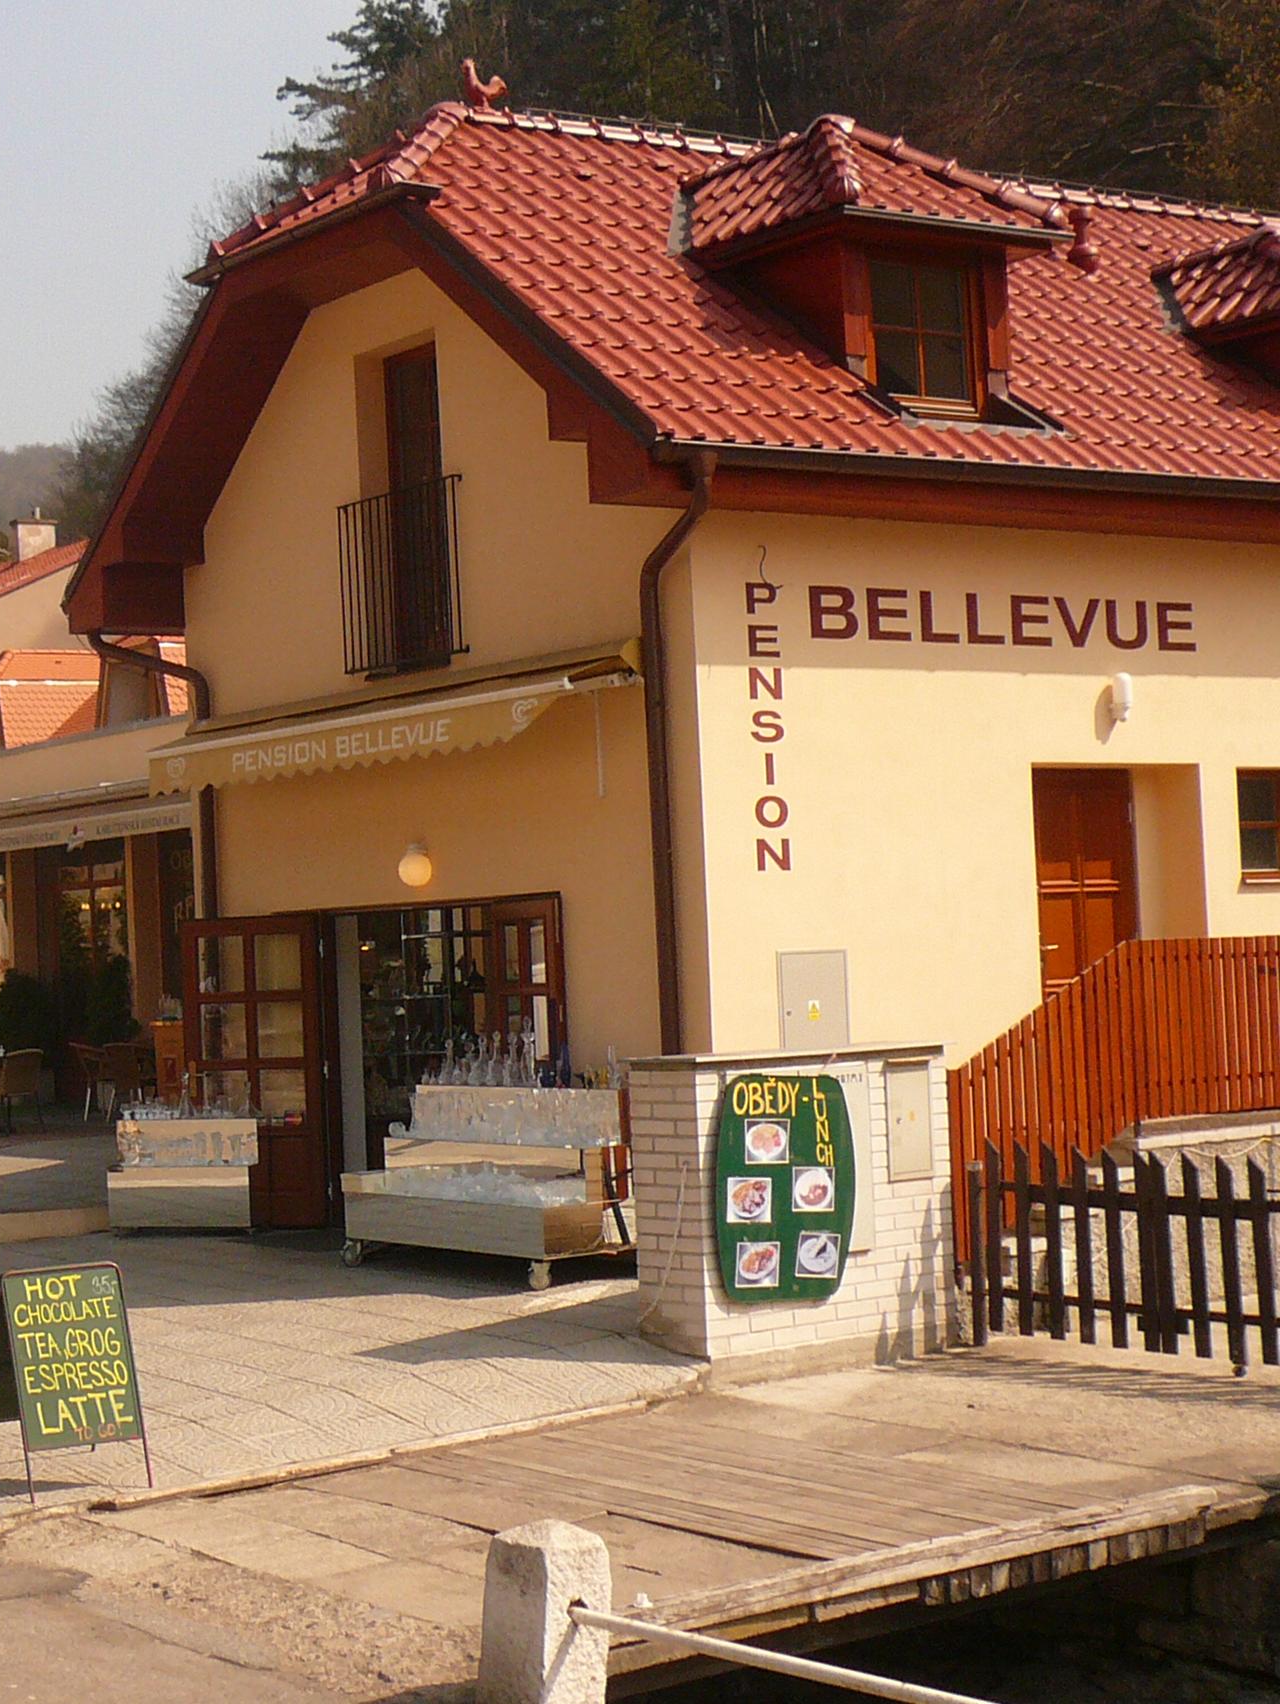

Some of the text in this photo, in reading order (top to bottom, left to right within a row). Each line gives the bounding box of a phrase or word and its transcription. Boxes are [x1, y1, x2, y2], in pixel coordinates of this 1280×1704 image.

[808, 585, 1197, 652] BELLEVUE
[232, 718, 451, 773] PENSION BELLEVUE
[745, 582, 791, 871] PENSION
[732, 1077, 800, 1117] OBĚDY
[812, 1078, 834, 1167] LUNCH
[23, 1274, 82, 1302] HOT
[14, 1296, 117, 1328] CHOCOLATE
[24, 1359, 129, 1395] ESPRESSO
[36, 1388, 133, 1435] LATTE
